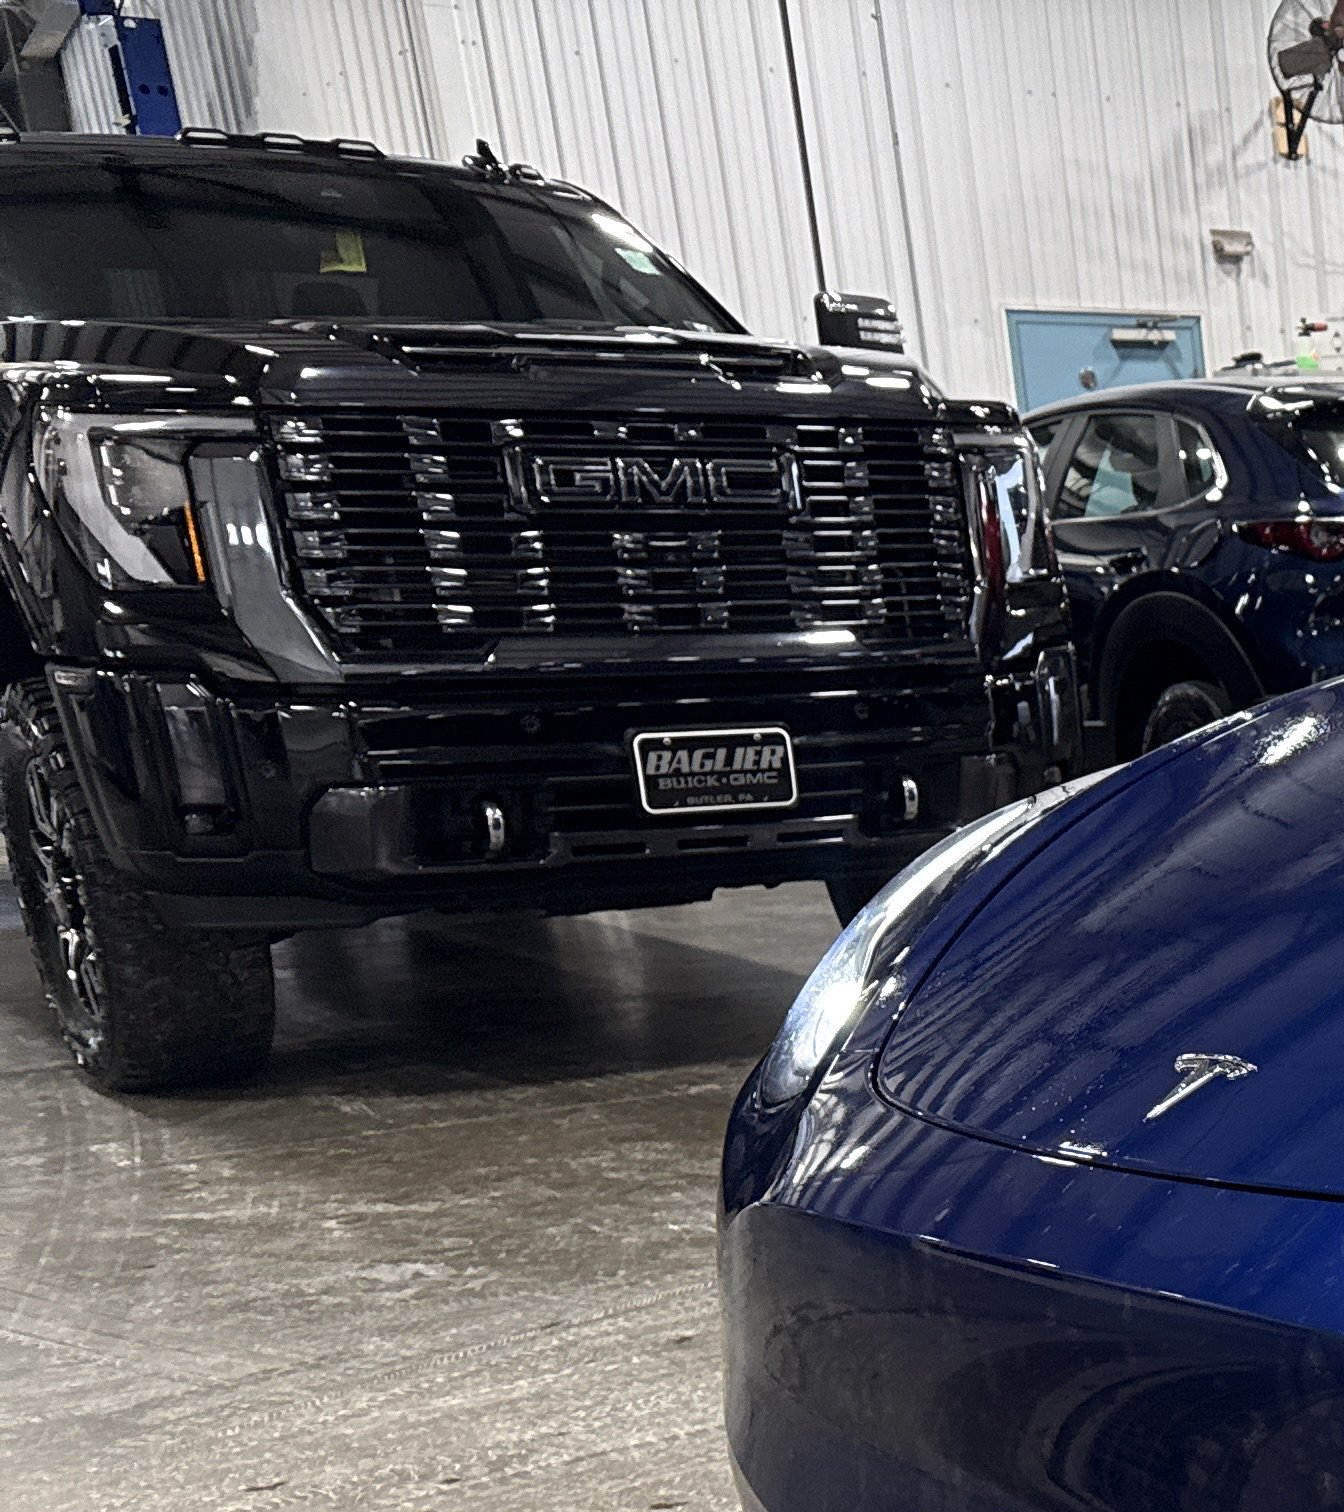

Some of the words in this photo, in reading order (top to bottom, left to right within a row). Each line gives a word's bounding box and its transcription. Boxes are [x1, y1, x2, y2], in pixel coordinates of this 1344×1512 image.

[533, 456, 782, 504] GMC
[646, 745, 785, 775] BAGLIER
[658, 774, 721, 790] BUICK
[729, 771, 779, 787] GMC
